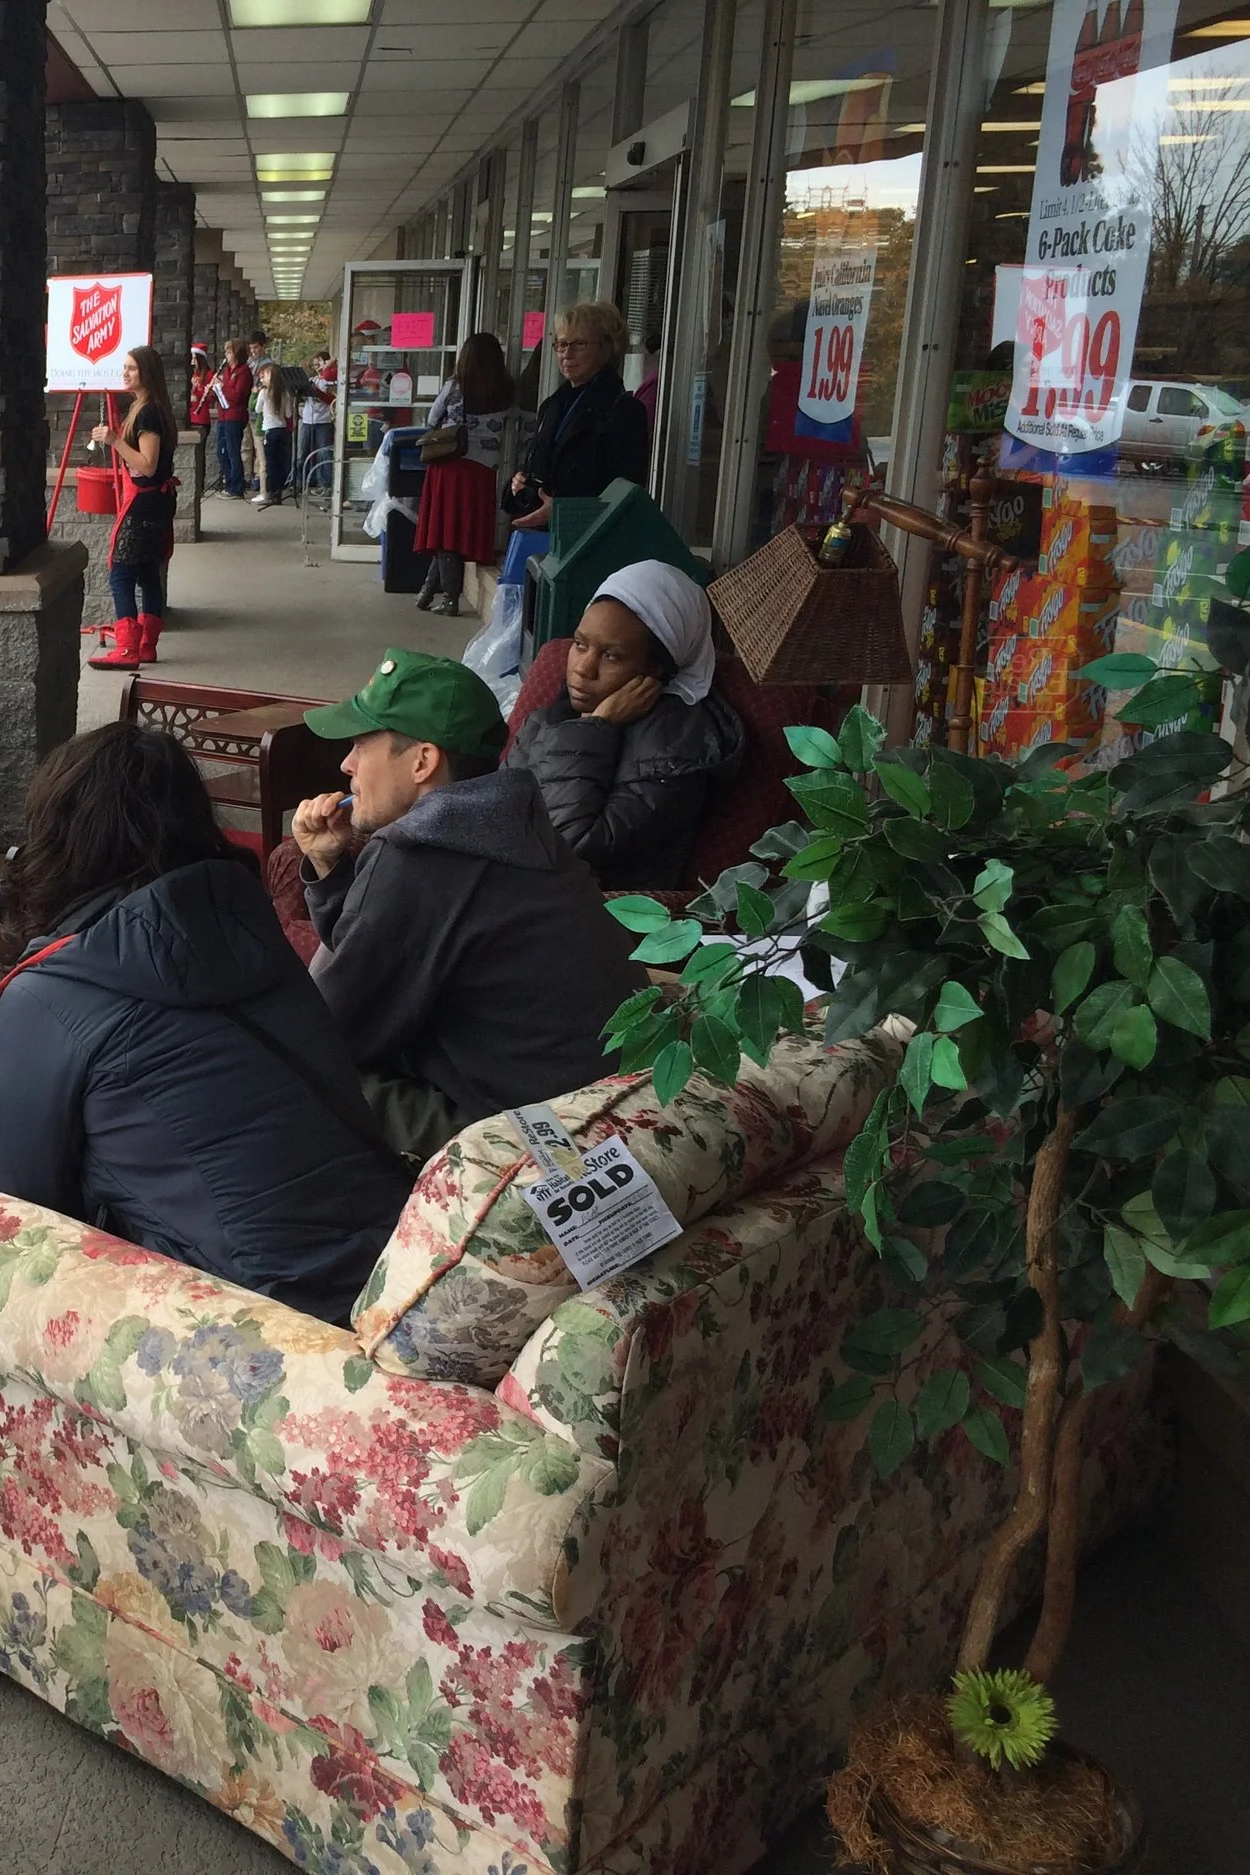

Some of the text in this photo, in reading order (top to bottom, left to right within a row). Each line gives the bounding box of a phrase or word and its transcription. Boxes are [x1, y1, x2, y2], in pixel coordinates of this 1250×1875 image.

[1038, 215, 1136, 260] 6-Pack Coke
[831, 258, 872, 287] California
[1045, 263, 1117, 300] Products
[72, 293, 118, 345] SALVATION
[80, 291, 101, 317] THE
[831, 292, 864, 321] Oranges
[87, 316, 116, 355] ARMY
[807, 325, 855, 402] 1.99
[1021, 310, 1121, 423] 1.99
[1016, 420, 1045, 436] Additional
[513, 1110, 540, 1146] ReStore
[531, 1121, 573, 1151] 2.99
[546, 1163, 634, 1227] SOLD
